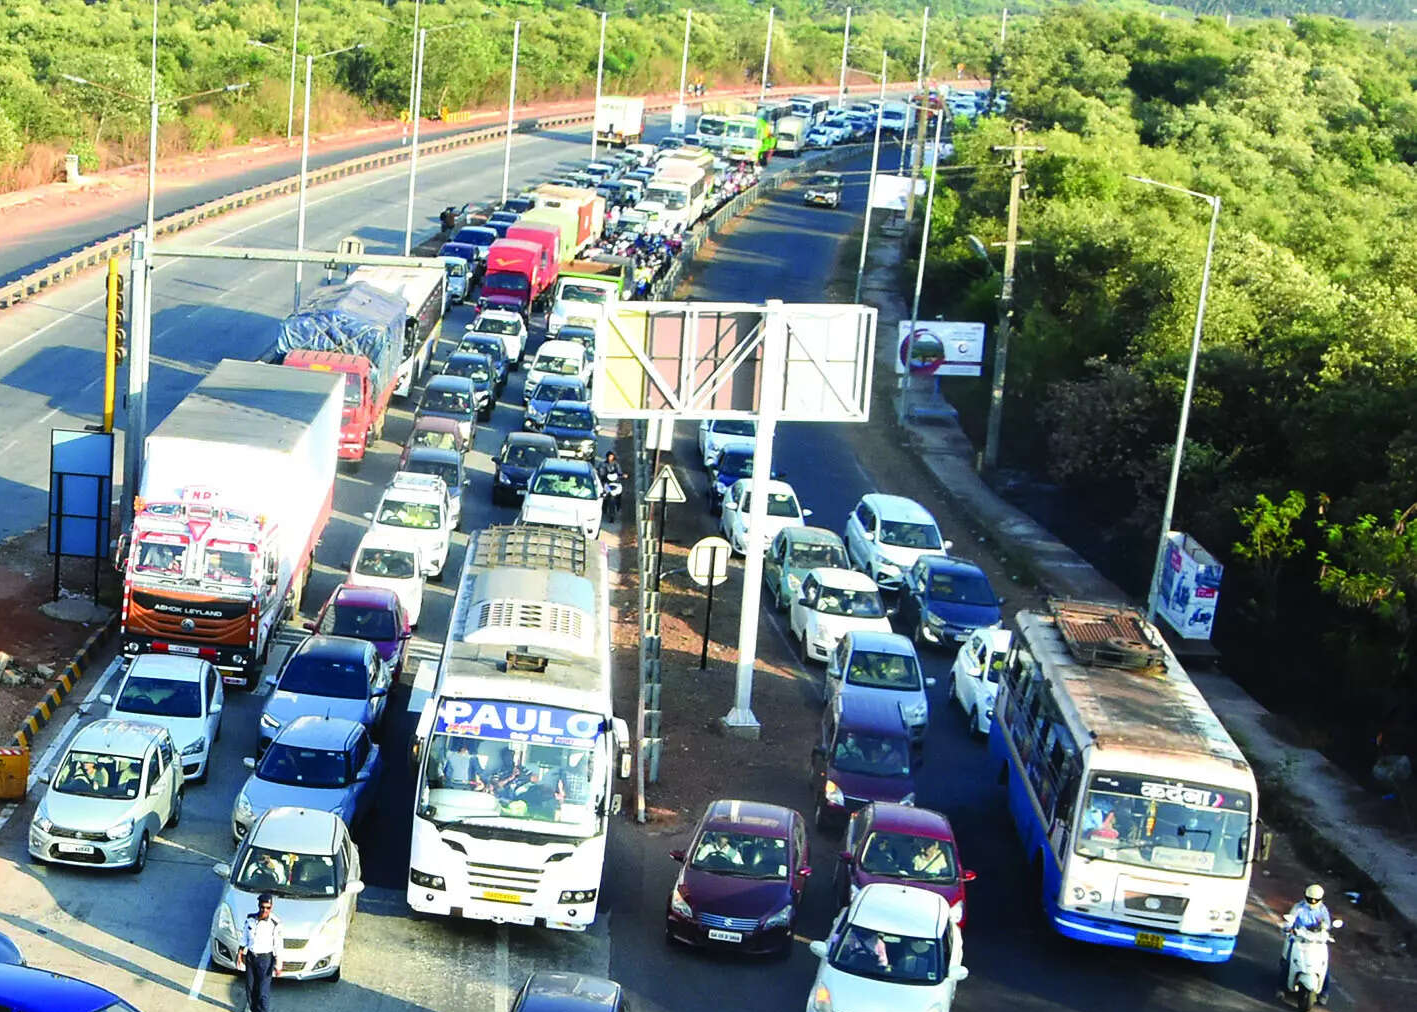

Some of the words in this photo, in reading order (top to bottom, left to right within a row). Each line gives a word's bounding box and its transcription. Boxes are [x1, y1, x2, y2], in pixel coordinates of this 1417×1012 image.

[154, 604, 182, 613] ASHOK
[184, 607, 223, 617] LEYLAND
[444, 701, 599, 738] PAULO
